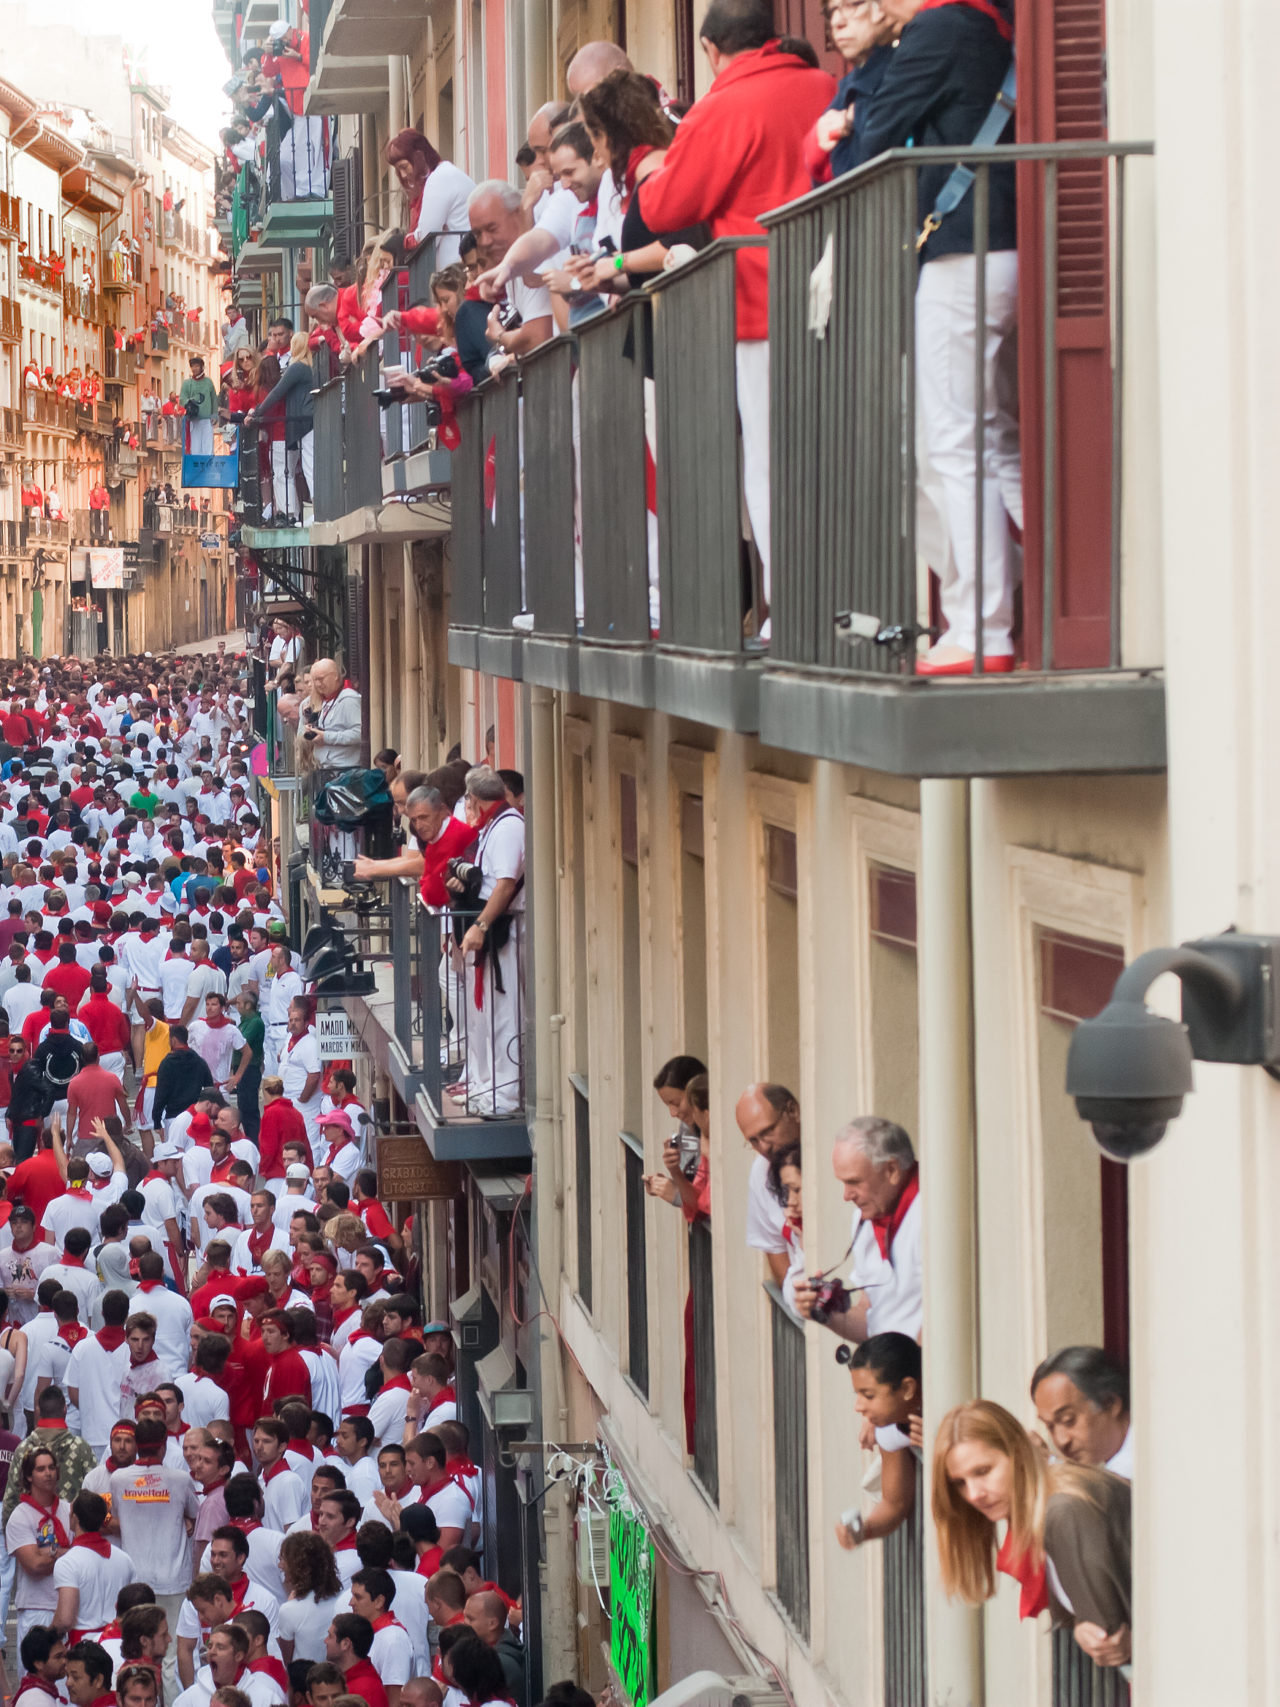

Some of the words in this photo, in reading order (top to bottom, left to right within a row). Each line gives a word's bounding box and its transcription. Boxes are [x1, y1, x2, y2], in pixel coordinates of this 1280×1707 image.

[320, 1020, 344, 1036] AMADO
[320, 1041, 343, 1054] MARCOS
[345, 1041, 349, 1053] Y
[124, 1488, 170, 1498] traveltalk
